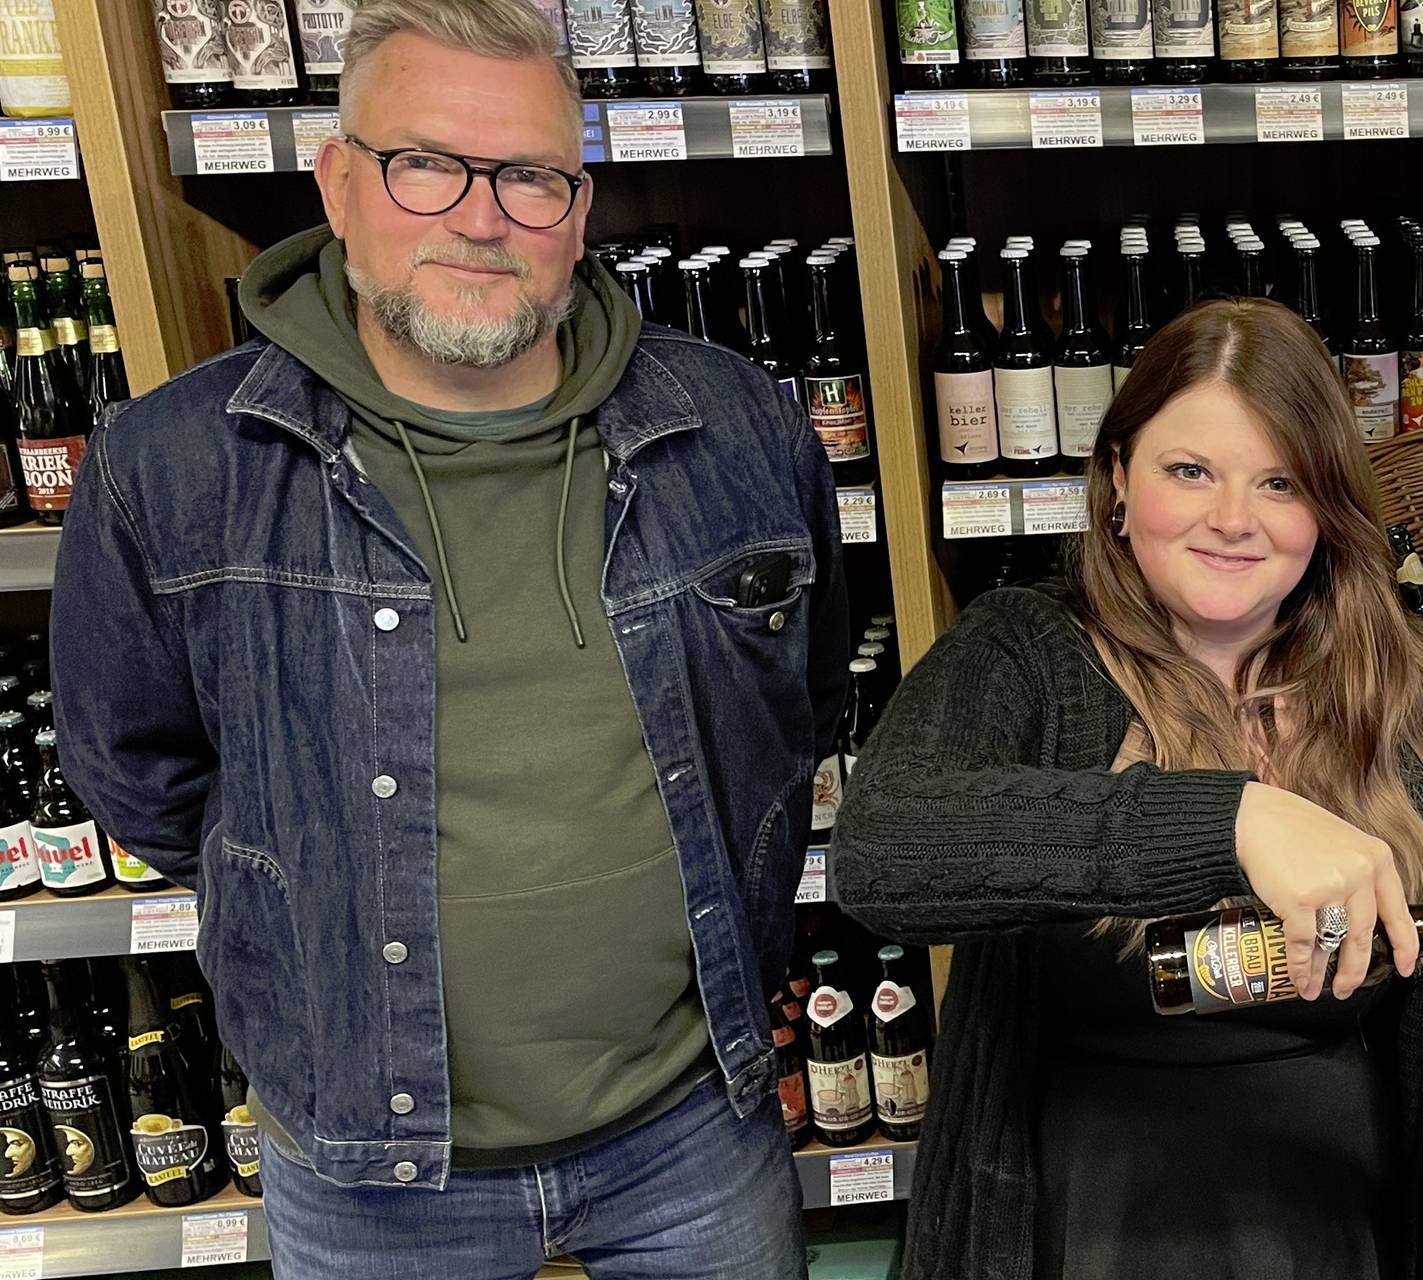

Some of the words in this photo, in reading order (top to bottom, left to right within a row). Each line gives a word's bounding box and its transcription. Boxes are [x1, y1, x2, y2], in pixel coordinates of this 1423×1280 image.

[1362, 6, 1380, 18] PILS
[713, 15, 734, 30] ELBE
[1168, 95, 1191, 105] 3,29
[1192, 94, 1198, 104] €
[1290, 94, 1310, 104] 2,49
[1312, 94, 1320, 102] €
[1376, 92, 1398, 102] 2,49
[1399, 91, 1406, 100] €
[934, 100, 955, 110] 3,19
[957, 100, 964, 109] €
[1067, 98, 1088, 108] 3,19
[1090, 97, 1097, 106] €
[648, 111, 670, 120] 2,99
[672, 110, 678, 118] €
[768, 109, 790, 118] 3,19
[792, 108, 798, 116] €
[233, 122, 256, 131] 3,09
[259, 120, 266, 129] €
[38, 126, 61, 136] 8,99
[62, 126, 70, 136] €
[1262, 130, 1318, 139] MEHRWEG
[1349, 128, 1404, 137] MEHRWEG
[906, 139, 964, 148] MEHRWEG
[1040, 136, 1096, 146] MEHRWEG
[1141, 133, 1198, 144] MEHRWEG
[620, 148, 680, 158] MEHRWEG
[739, 146, 798, 155] MEHRWEG
[204, 160, 266, 170] MEHRWEG
[8, 167, 70, 177] MEHRWEG
[949, 406, 987, 414] keller
[951, 416, 988, 426] bier
[22, 454, 70, 470] KRIEK
[24, 470, 73, 488] BOON
[950, 525, 1006, 535] MEHRWEG
[1032, 522, 1088, 532] MEHRWEG
[170, 904, 191, 913] 2,89
[138, 939, 195, 950] MEHRWEG
[1223, 927, 1244, 988] KELLERBIER
[42, 1084, 94, 1100] STRAFFE
[864, 1157, 882, 1167] 4,29
[884, 1156, 890, 1164] €
[837, 1191, 888, 1202] MEHRWEG
[187, 1252, 242, 1264] MEHRWEG
